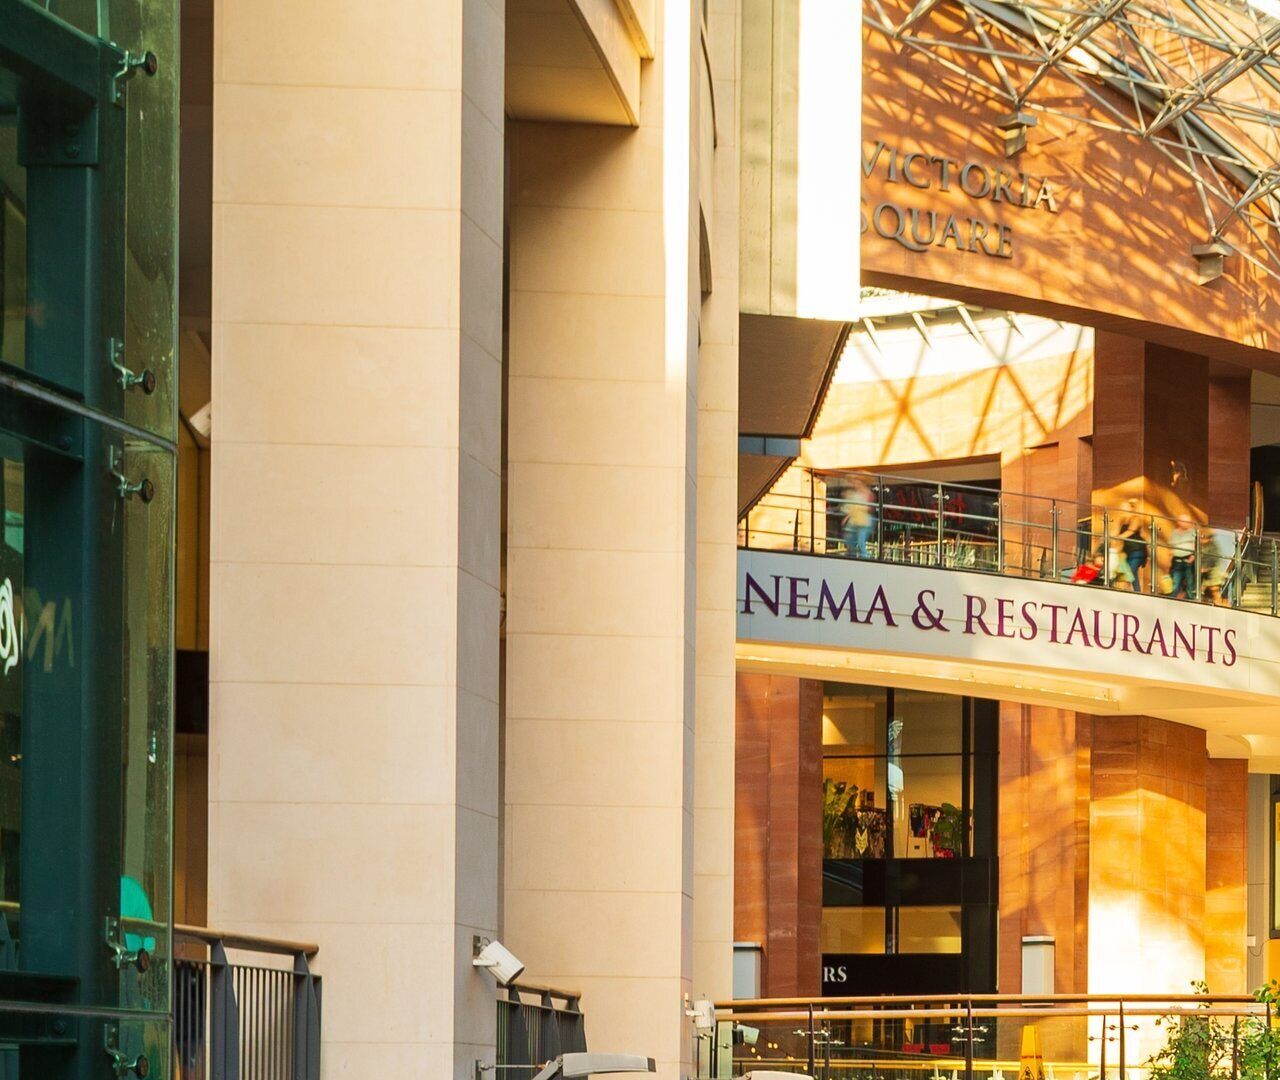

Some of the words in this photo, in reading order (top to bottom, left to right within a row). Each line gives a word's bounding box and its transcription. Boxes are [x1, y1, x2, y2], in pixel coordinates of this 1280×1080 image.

[861, 141, 1058, 213] VICTORIA
[736, 571, 898, 627] NEMA
[910, 589, 950, 632] &
[963, 593, 1237, 667] RESTAURANTS
[823, 966, 848, 983] RS
